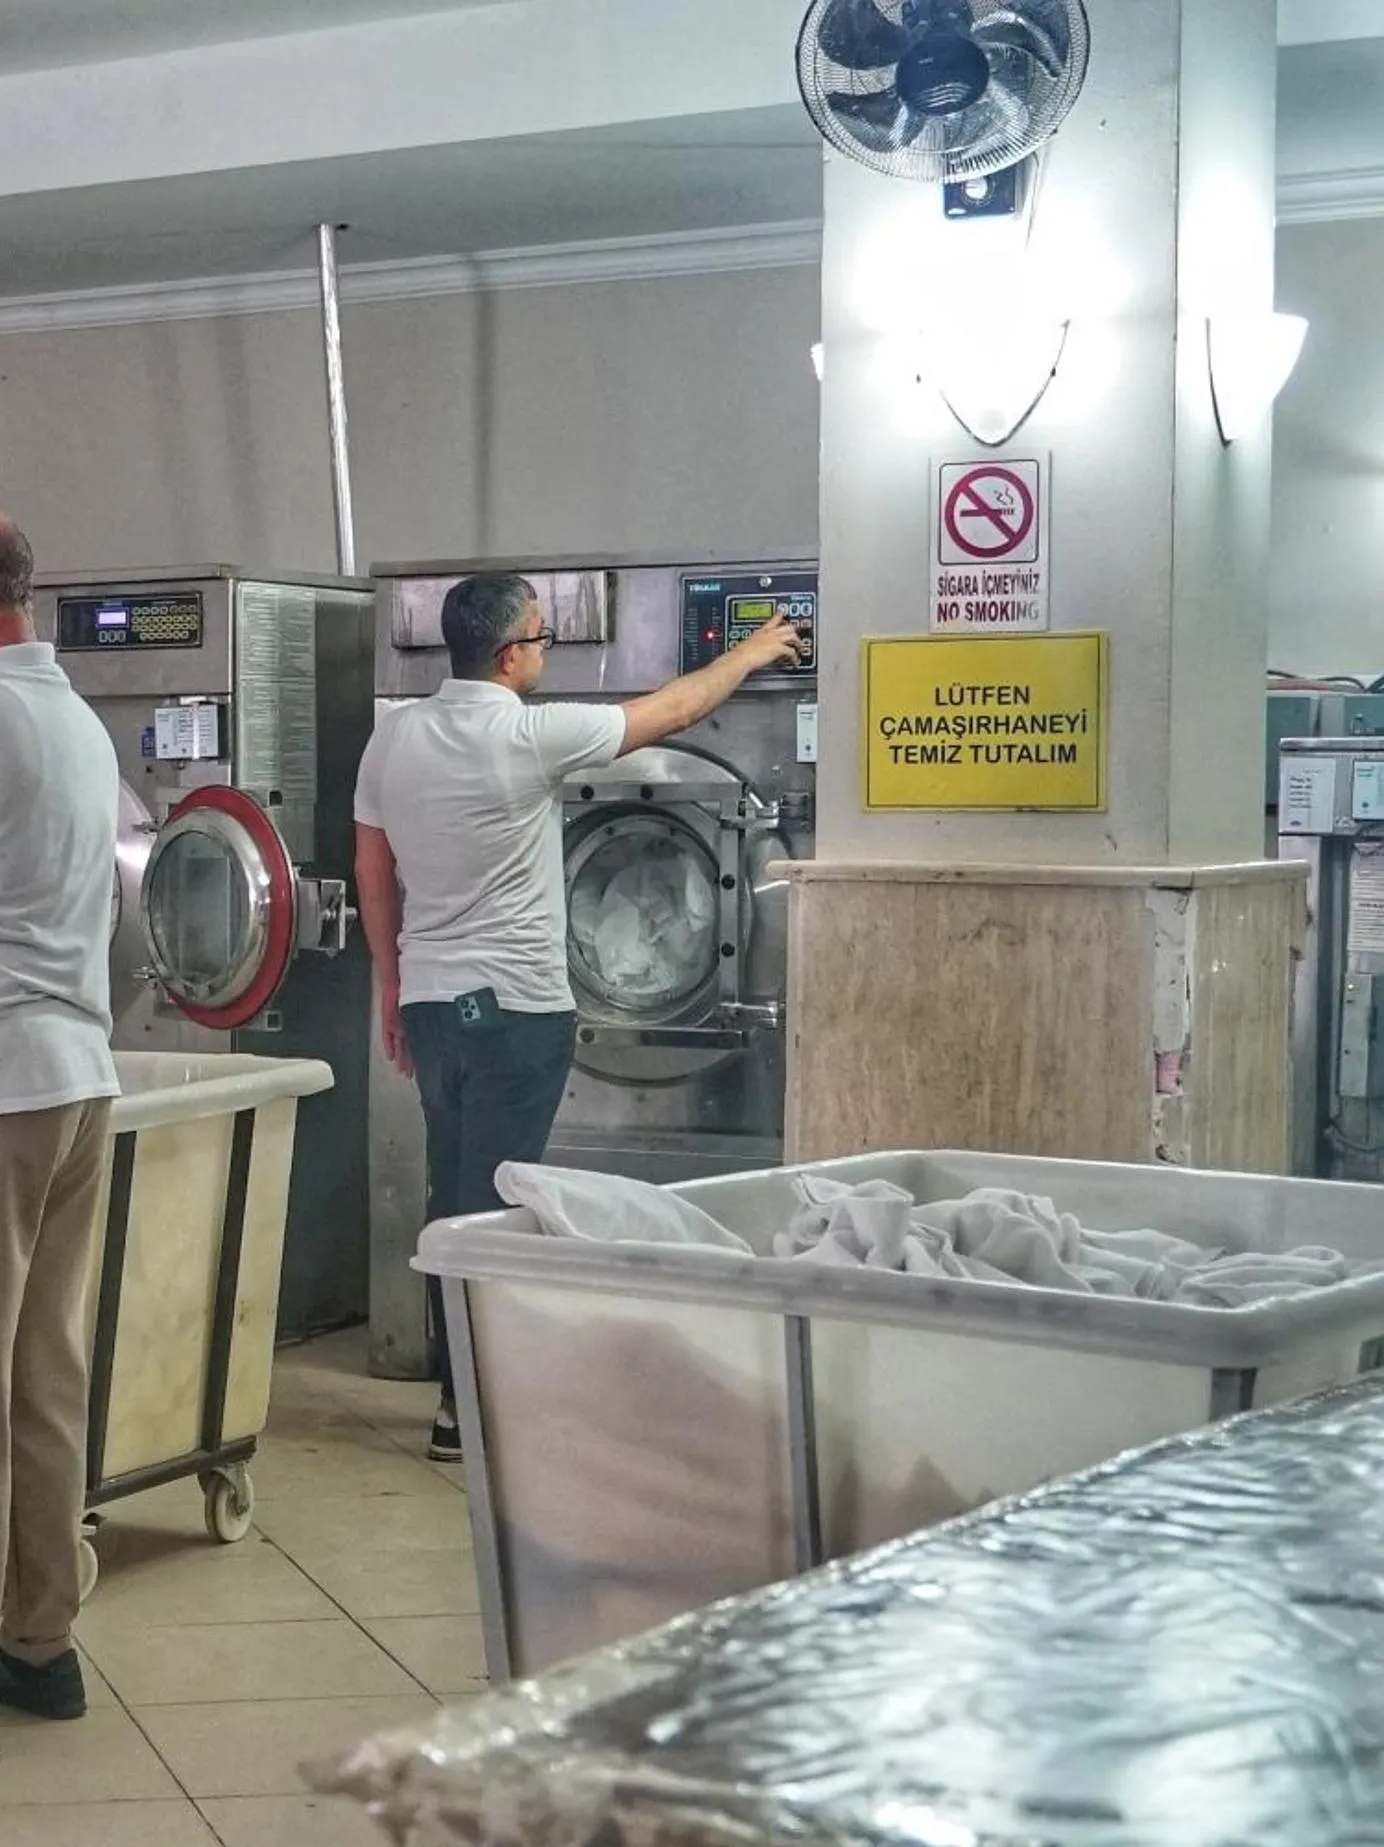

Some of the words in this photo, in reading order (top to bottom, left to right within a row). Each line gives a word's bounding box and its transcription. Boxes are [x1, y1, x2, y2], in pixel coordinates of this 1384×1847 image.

[937, 571, 979, 597] SİGARA
[937, 601, 960, 623] NO
[964, 600, 1040, 623] SMOKING
[935, 682, 1030, 706] LÜTFEN
[879, 708, 1088, 740] ÇAMAŞIRHANEYİ
[889, 740, 962, 764] TEMİZ
[968, 744, 1077, 764] TUTALIM
